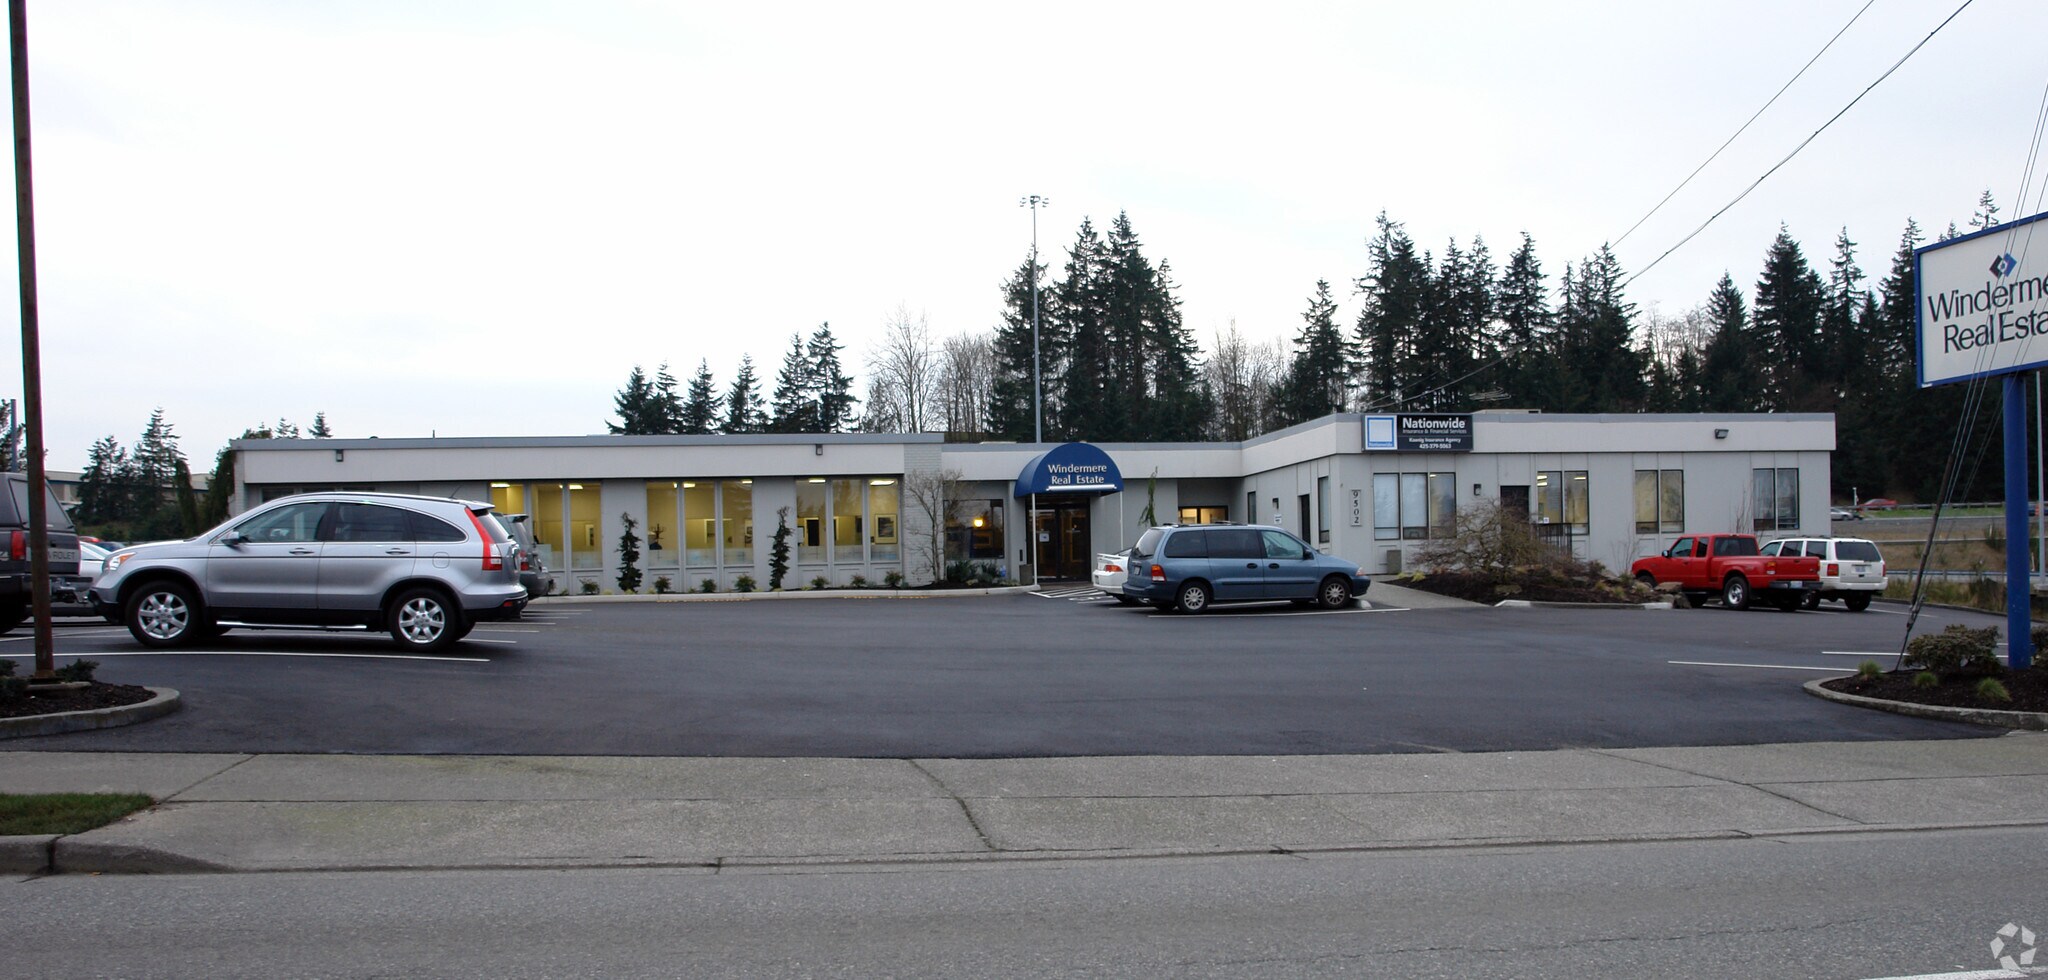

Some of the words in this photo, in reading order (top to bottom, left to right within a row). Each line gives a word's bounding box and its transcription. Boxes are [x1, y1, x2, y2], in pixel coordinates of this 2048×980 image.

[1943, 314, 1995, 354] Real
[1402, 417, 1466, 429] Nationwide
[1047, 464, 1107, 474] Windermere
[1051, 475, 1071, 485] Real
[1076, 475, 1105, 485] Estate
